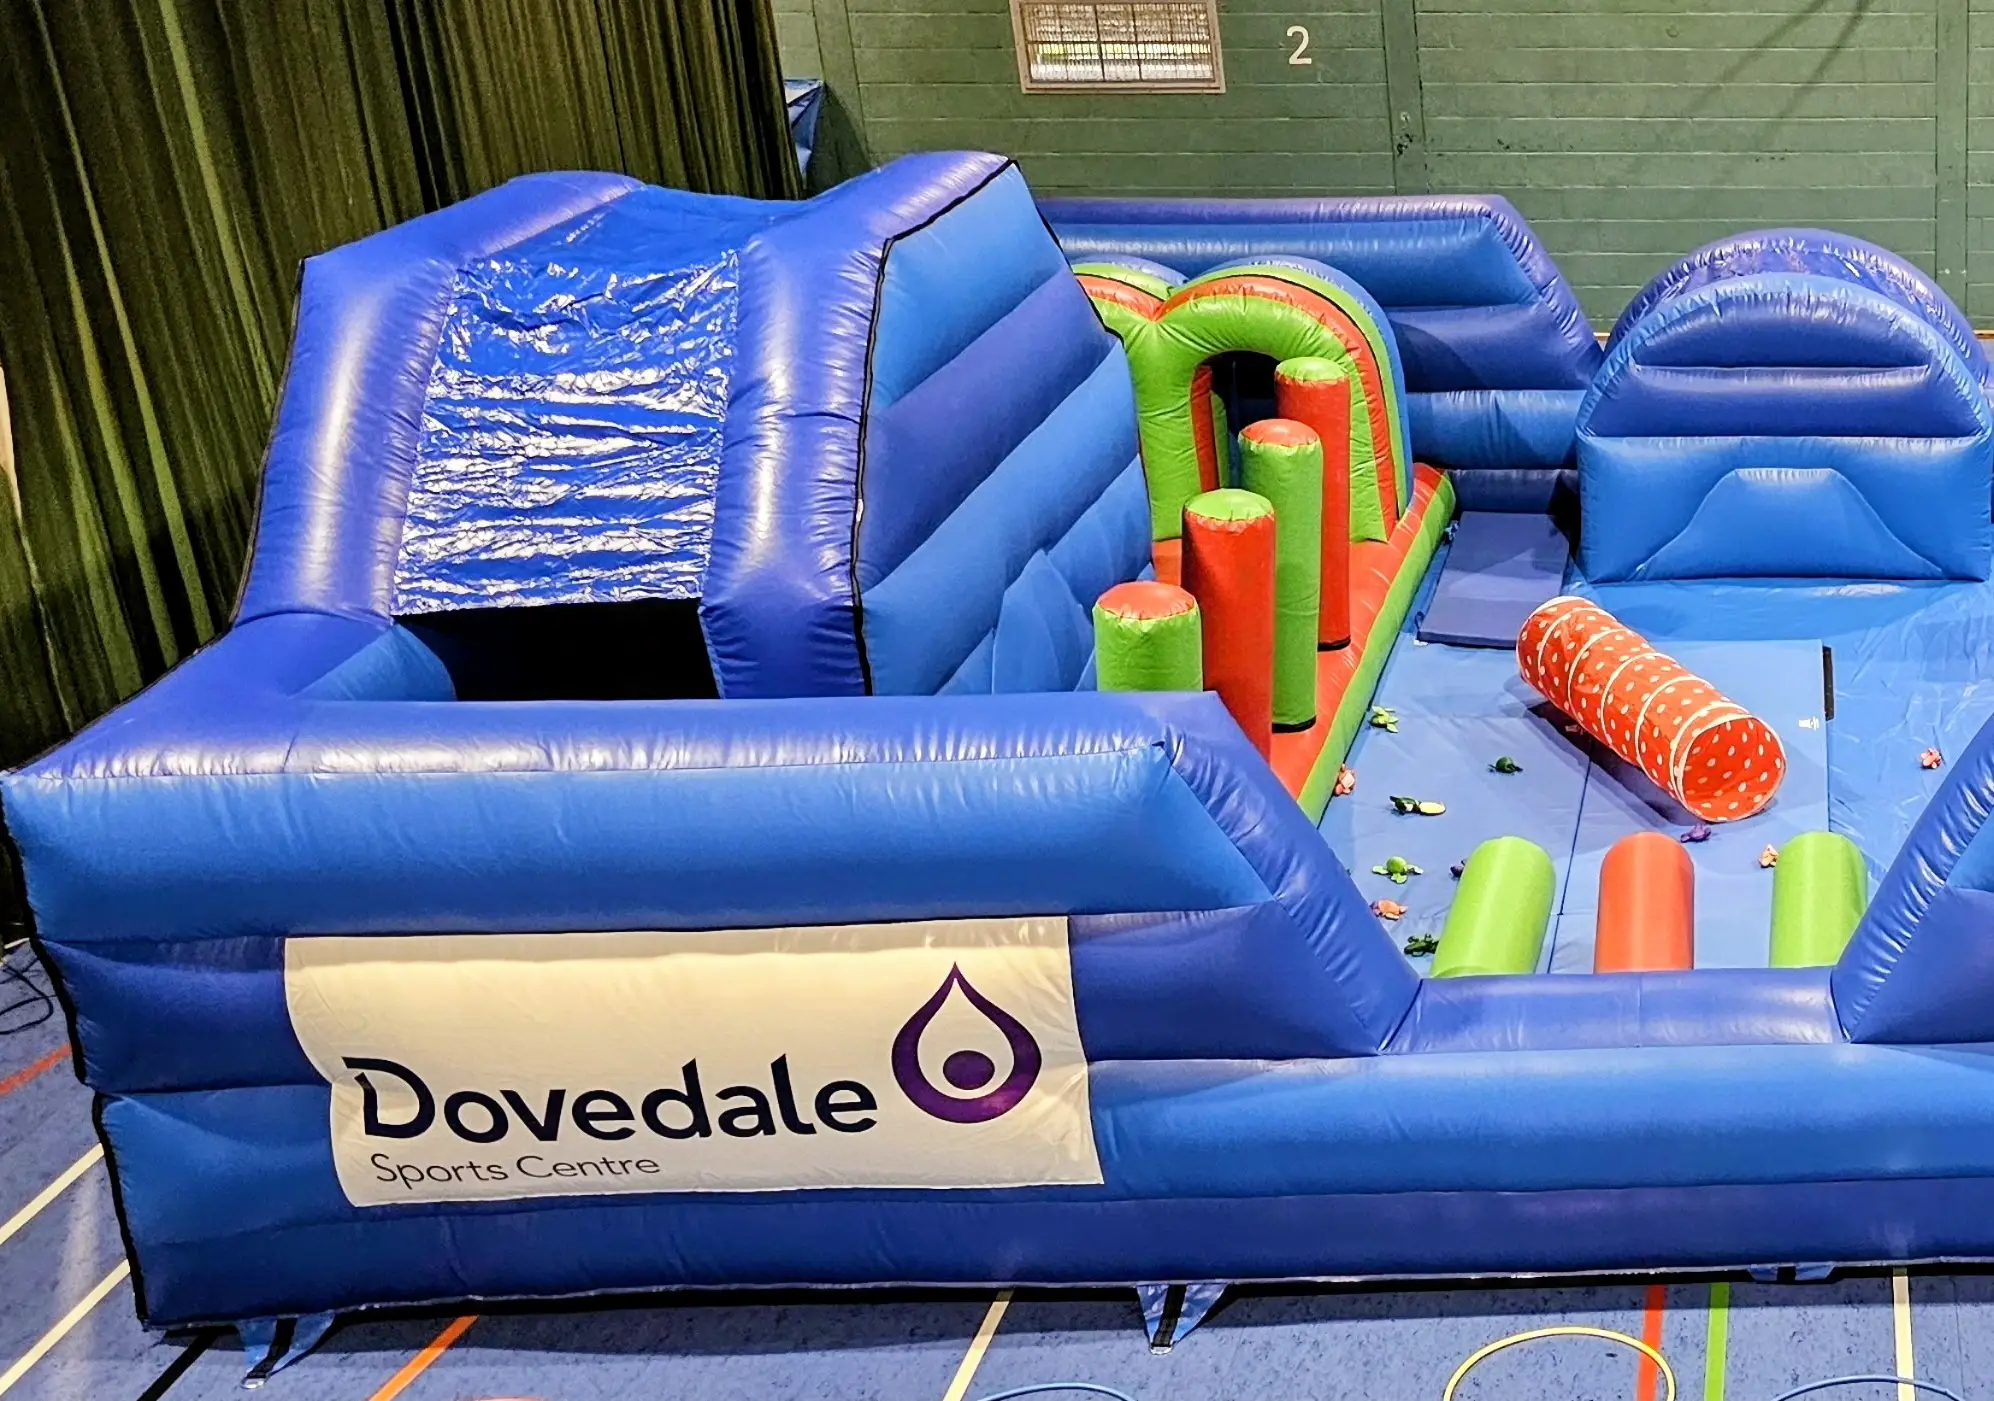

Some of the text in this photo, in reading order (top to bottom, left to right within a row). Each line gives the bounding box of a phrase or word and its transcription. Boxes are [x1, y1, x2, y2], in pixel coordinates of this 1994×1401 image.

[1286, 26, 1312, 65] 2
[341, 1053, 878, 1142] Dovedale
[372, 1152, 660, 1190] Sports Centre
